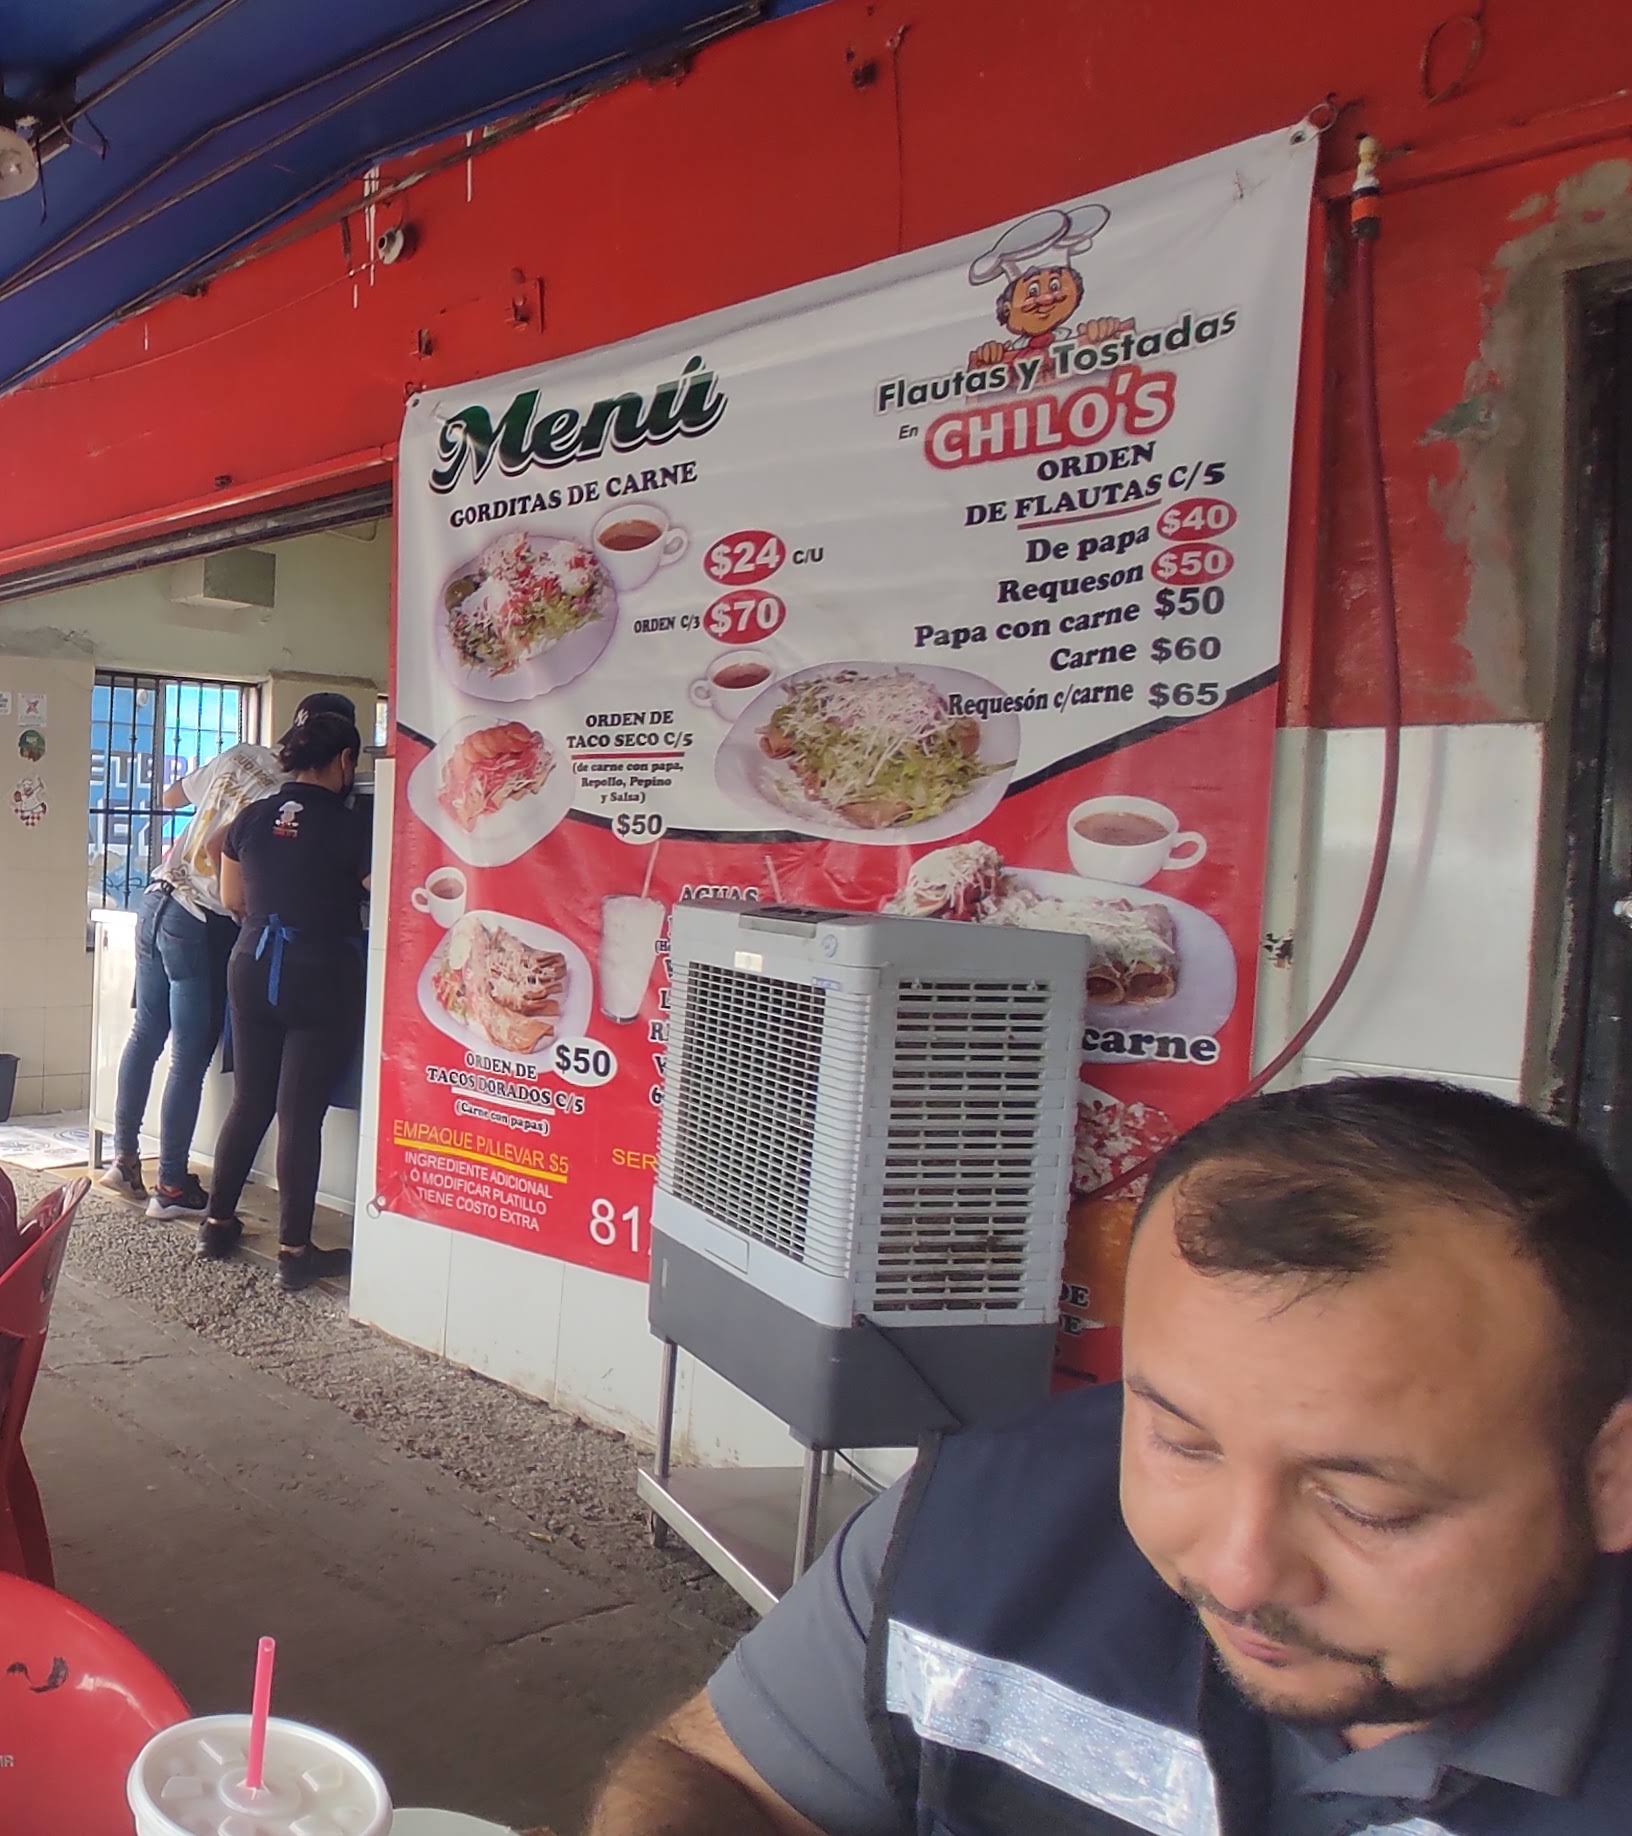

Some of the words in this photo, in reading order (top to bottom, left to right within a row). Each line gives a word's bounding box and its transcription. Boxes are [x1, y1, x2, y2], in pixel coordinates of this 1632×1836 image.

[878, 366, 1007, 413] Flautas
[1017, 357, 1040, 391] y
[1051, 308, 1238, 376] Tostadas
[429, 354, 728, 493] Menú
[898, 424, 919, 440] En
[929, 370, 1171, 465] CHILO'S
[1036, 441, 1157, 481] ORDEN
[450, 486, 562, 528] GORDITAS
[568, 481, 600, 507] DE
[606, 461, 698, 497] CARNE
[965, 502, 1008, 526] DE
[1014, 473, 1162, 519] FLAUTAS
[1168, 461, 1227, 492] C/5
[1026, 538, 1069, 562] De
[1076, 525, 1150, 561] papa
[1160, 504, 1230, 537] $40
[711, 539, 780, 580] $24
[792, 547, 825, 566] C/U
[997, 563, 1144, 604] Requeson
[1155, 548, 1228, 578] $50
[633, 616, 676, 634] ORDEN
[680, 613, 701, 632] C/3
[710, 600, 780, 640] $70
[914, 623, 986, 650] Papa
[996, 618, 1050, 641] con
[1058, 603, 1141, 635] carne
[1154, 586, 1225, 619] $50
[1050, 643, 1137, 672] Carne
[1150, 636, 1221, 665] $60
[585, 712, 646, 727] ORDEN
[649, 710, 674, 724] DE
[948, 688, 1049, 720] Requesón
[1054, 681, 1134, 713] c/carne
[1148, 681, 1220, 710] $65
[567, 734, 610, 749] TACO
[614, 733, 659, 747] SECO
[663, 732, 693, 748] C/5
[572, 762, 589, 773] (de
[591, 762, 624, 772] carne
[626, 762, 648, 771] con
[651, 761, 684, 773] papa,
[581, 777, 626, 788] Repollo,
[629, 776, 672, 788] Pepino
[600, 795, 607, 804] y
[610, 791, 646, 804] Salsa)
[617, 813, 663, 837] $50
[466, 1052, 512, 1074] ORDEN
[515, 1062, 537, 1080] DE
[555, 1044, 611, 1078] $50
[427, 1067, 475, 1089] TACOS
[477, 1077, 551, 1105] DORADOS
[555, 1093, 584, 1113] C/5
[456, 1100, 489, 1118] (Carne
[490, 1111, 508, 1123] con
[510, 1114, 549, 1135] papas)
[393, 1119, 473, 1150] EMPAQUE
[476, 1136, 545, 1169] P/LLEVAR
[549, 1151, 568, 1174] $5
[405, 1151, 489, 1181] INGREDIENTE
[490, 1170, 554, 1199] ADICIONAL
[422, 1172, 491, 1199] MODIFICAR
[493, 1188, 546, 1216] PLATILLO
[416, 1186, 454, 1207] TIENE
[456, 1196, 497, 1219] COSTO
[499, 1209, 540, 1232] EXTRA
